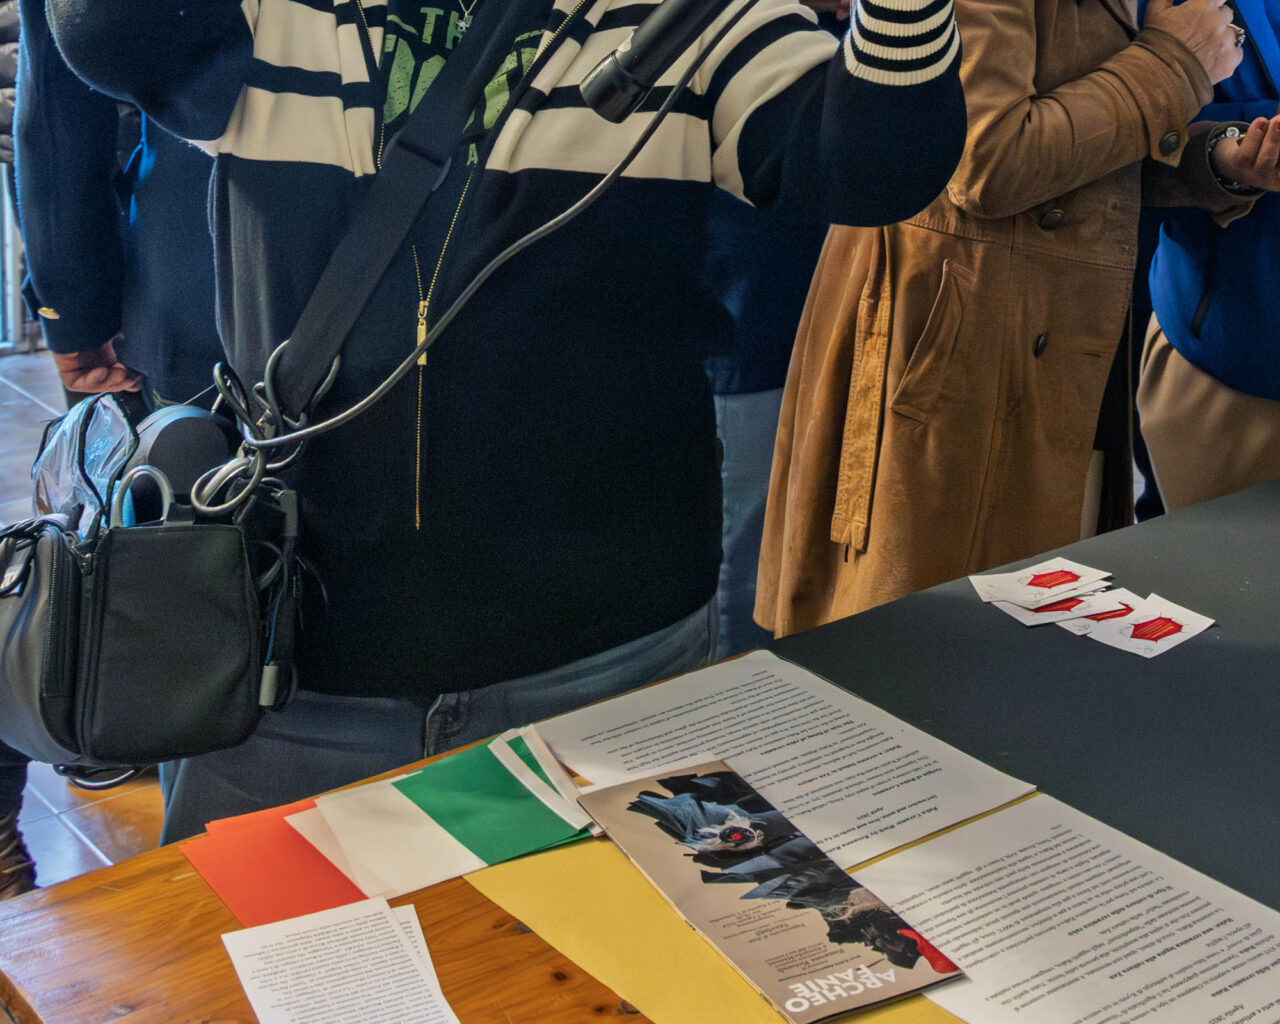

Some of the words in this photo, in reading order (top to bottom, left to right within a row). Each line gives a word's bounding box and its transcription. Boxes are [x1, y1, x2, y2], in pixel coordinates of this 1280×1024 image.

[878, 824, 896, 833] Work
[841, 834, 870, 847] Rosanna
[1108, 971, 1124, 980] Zen
[1255, 965, 1271, 975] della
[787, 962, 870, 999] FANIE
[1228, 973, 1256, 989] ceramica
[784, 966, 898, 1014] ARCHEO
[1224, 1004, 1245, 1017] Aprile
[1261, 1002, 1275, 1012] arte
